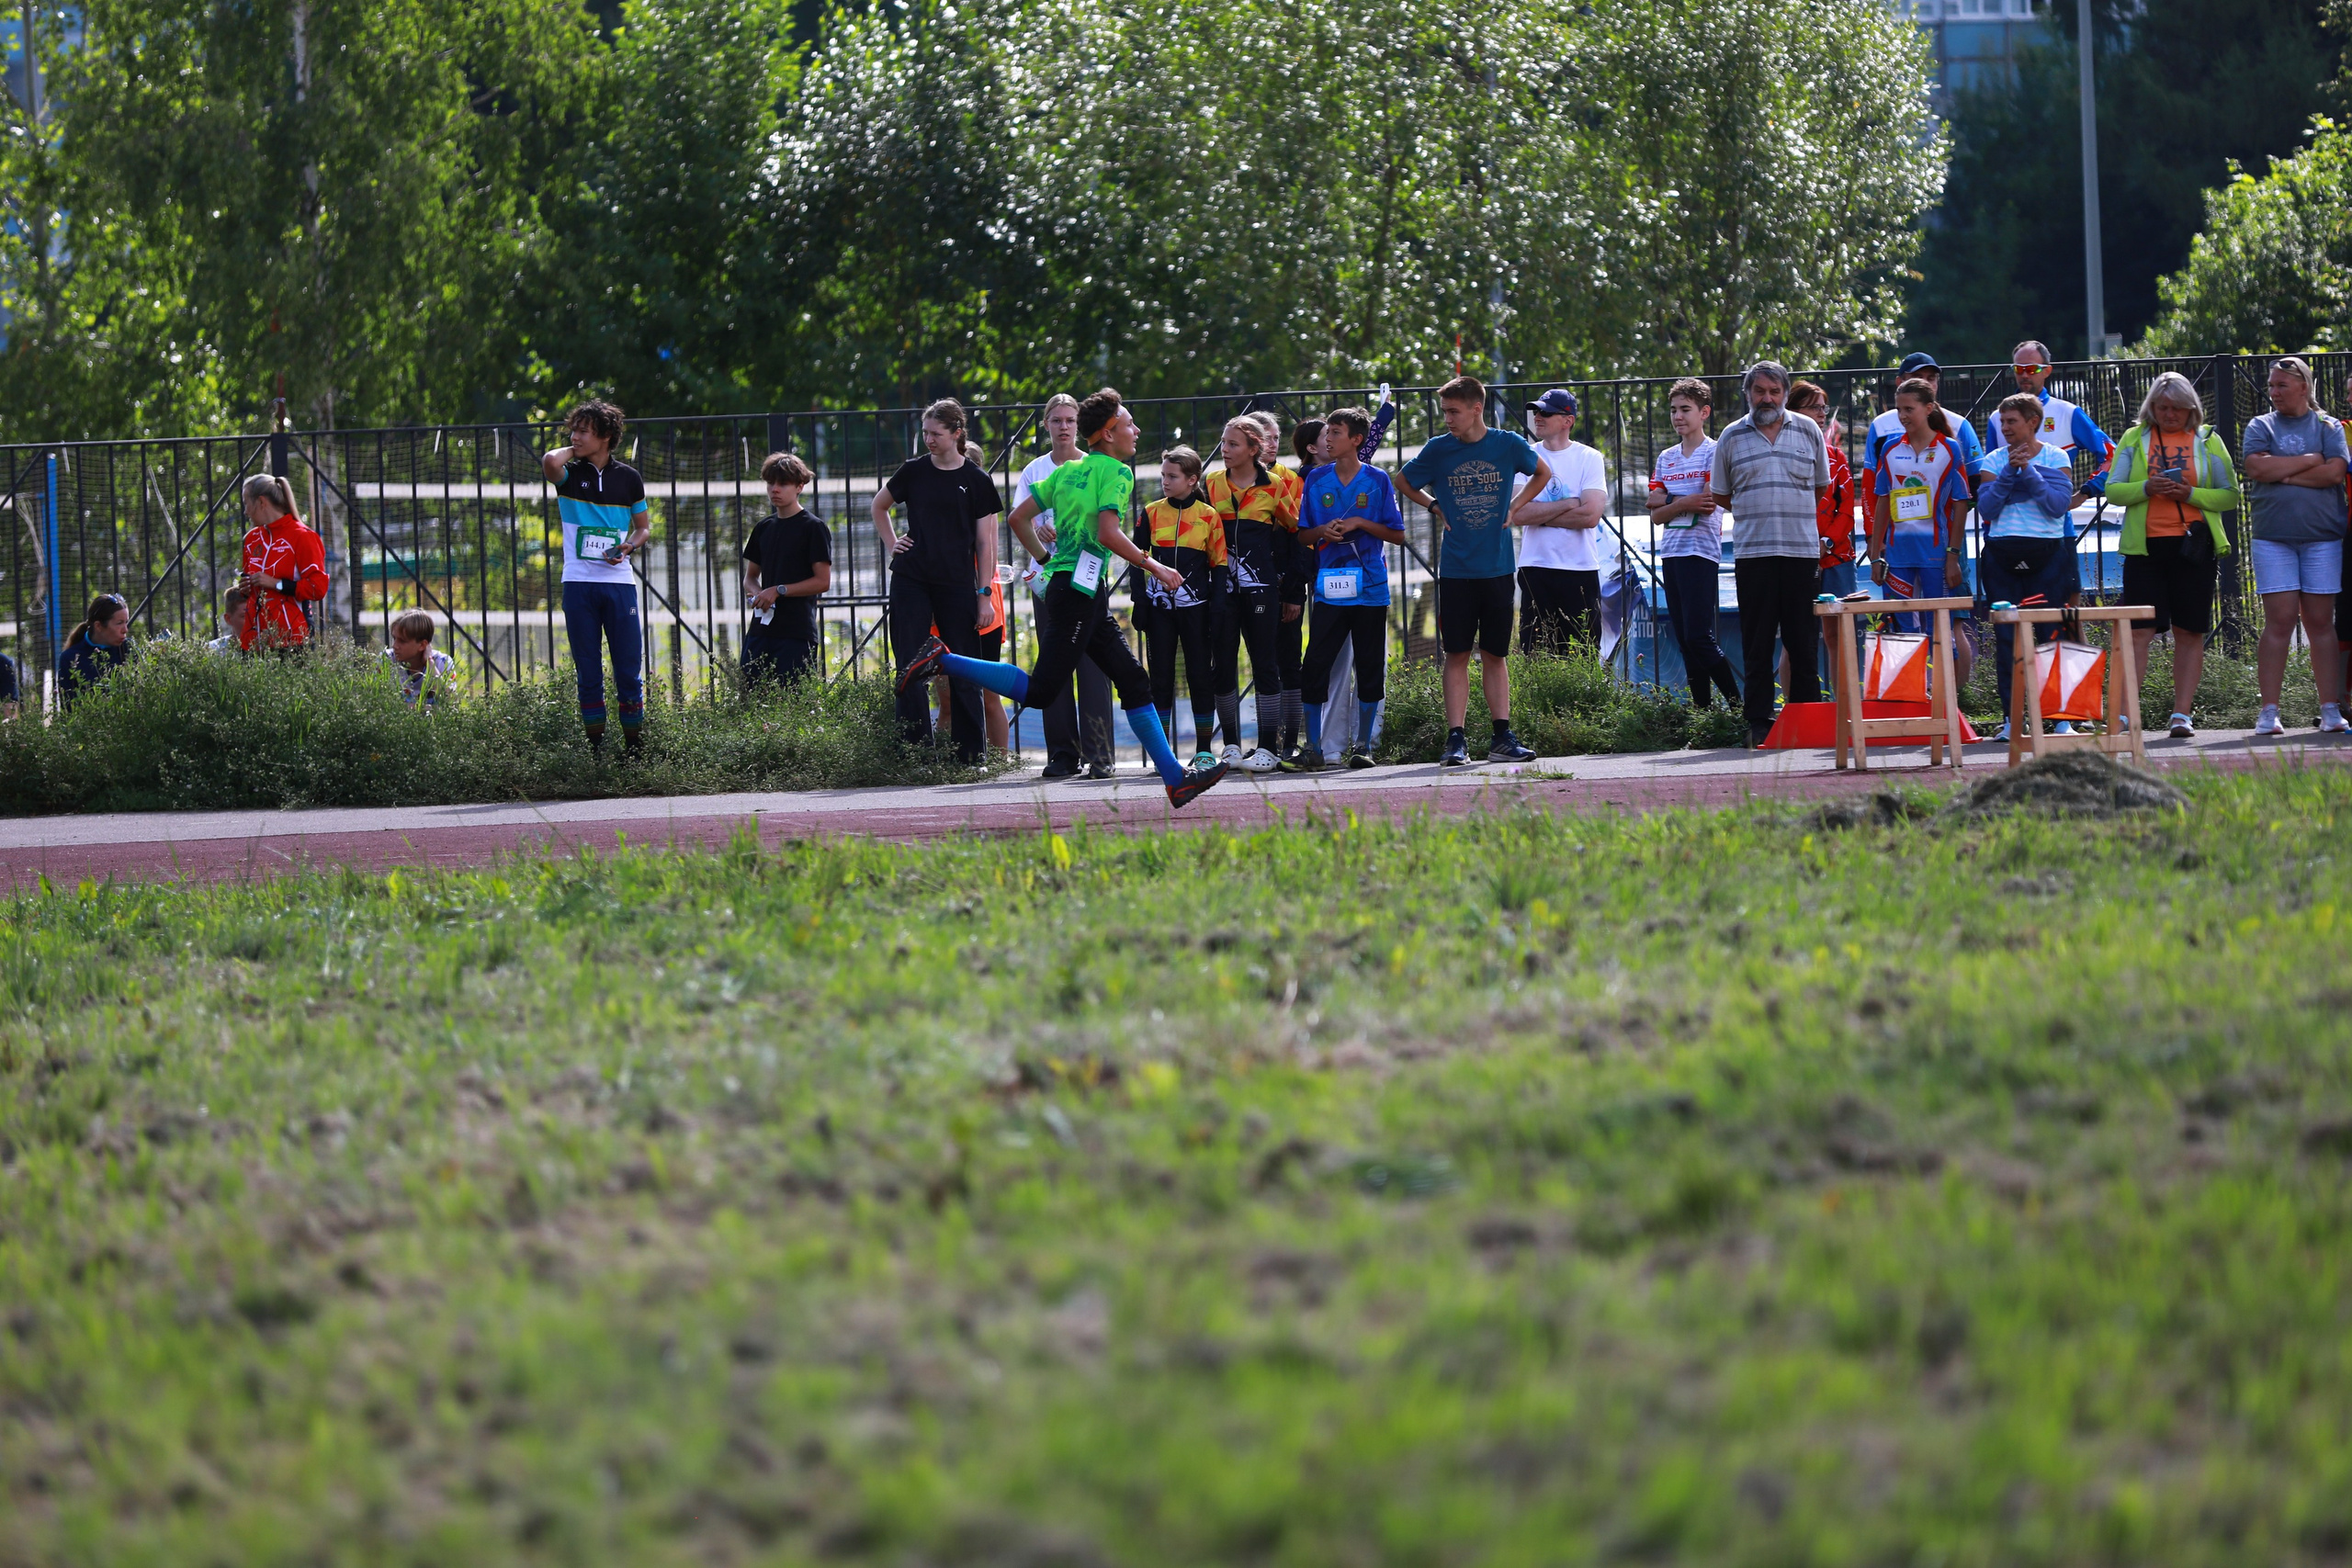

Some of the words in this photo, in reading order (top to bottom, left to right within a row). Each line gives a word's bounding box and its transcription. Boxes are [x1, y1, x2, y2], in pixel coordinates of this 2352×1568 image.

[1448, 476, 1474, 487] FREE
[1477, 472, 1503, 485] SOUL
[1458, 487, 1466, 495] 18
[1484, 484, 1493, 492] 65
[1900, 501, 1920, 509] 220.1
[585, 540, 605, 549] 144.1
[1086, 559, 1097, 581] 103.3
[1329, 581, 1350, 590] 311.3
